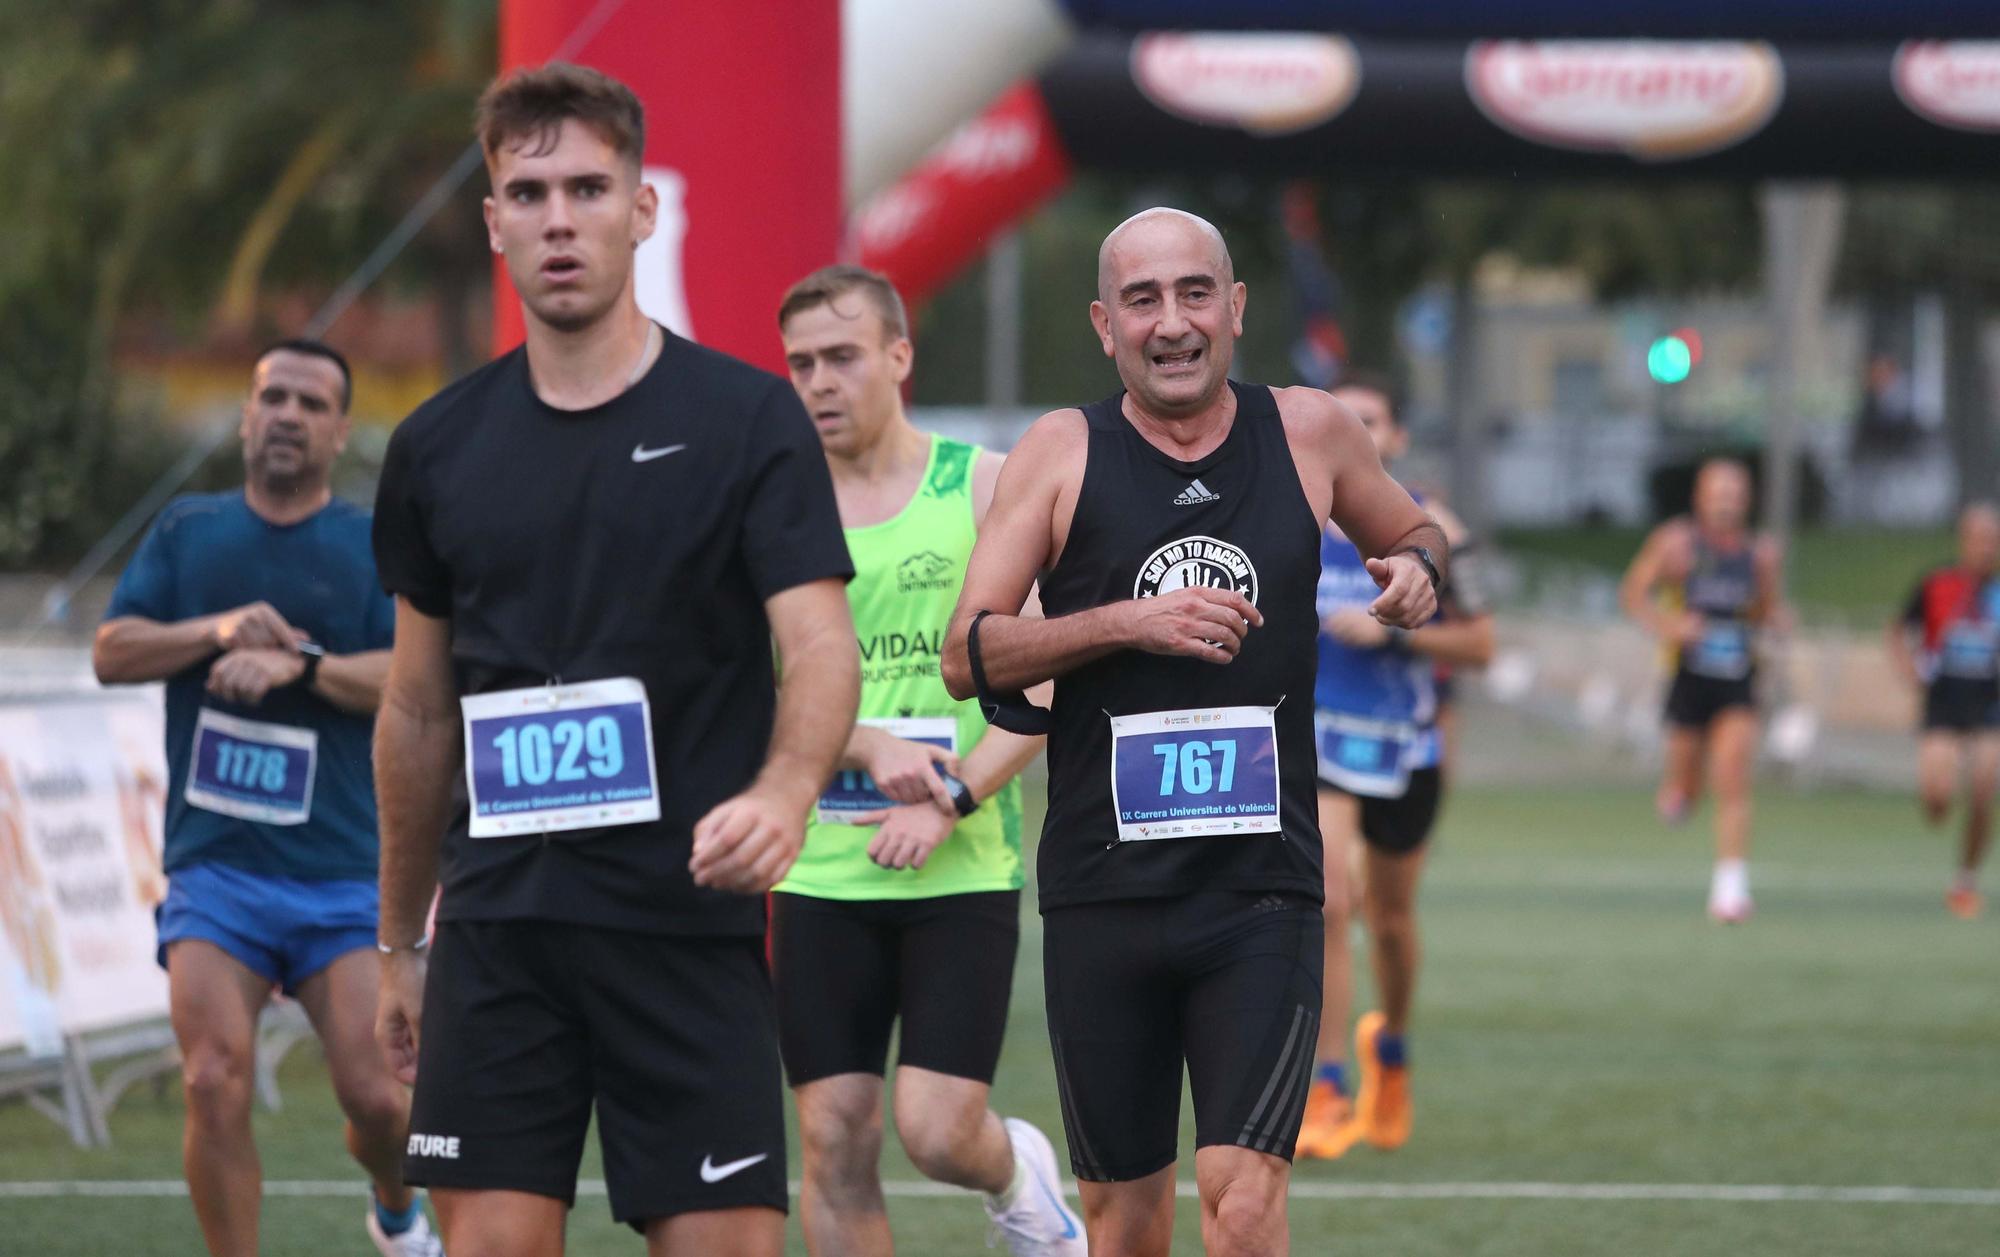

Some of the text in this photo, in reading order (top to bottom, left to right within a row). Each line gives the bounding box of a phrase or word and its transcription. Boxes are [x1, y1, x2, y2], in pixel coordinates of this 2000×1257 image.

[1173, 493, 1220, 505] adidas
[1144, 541, 1249, 584] SAY NO TO RACISM
[857, 630, 940, 662] VIDAL
[216, 741, 287, 793] 1178
[493, 715, 624, 787] 1029
[1153, 739, 1236, 796] 767
[1122, 802, 1276, 820] IX Carrera Universitat de València
